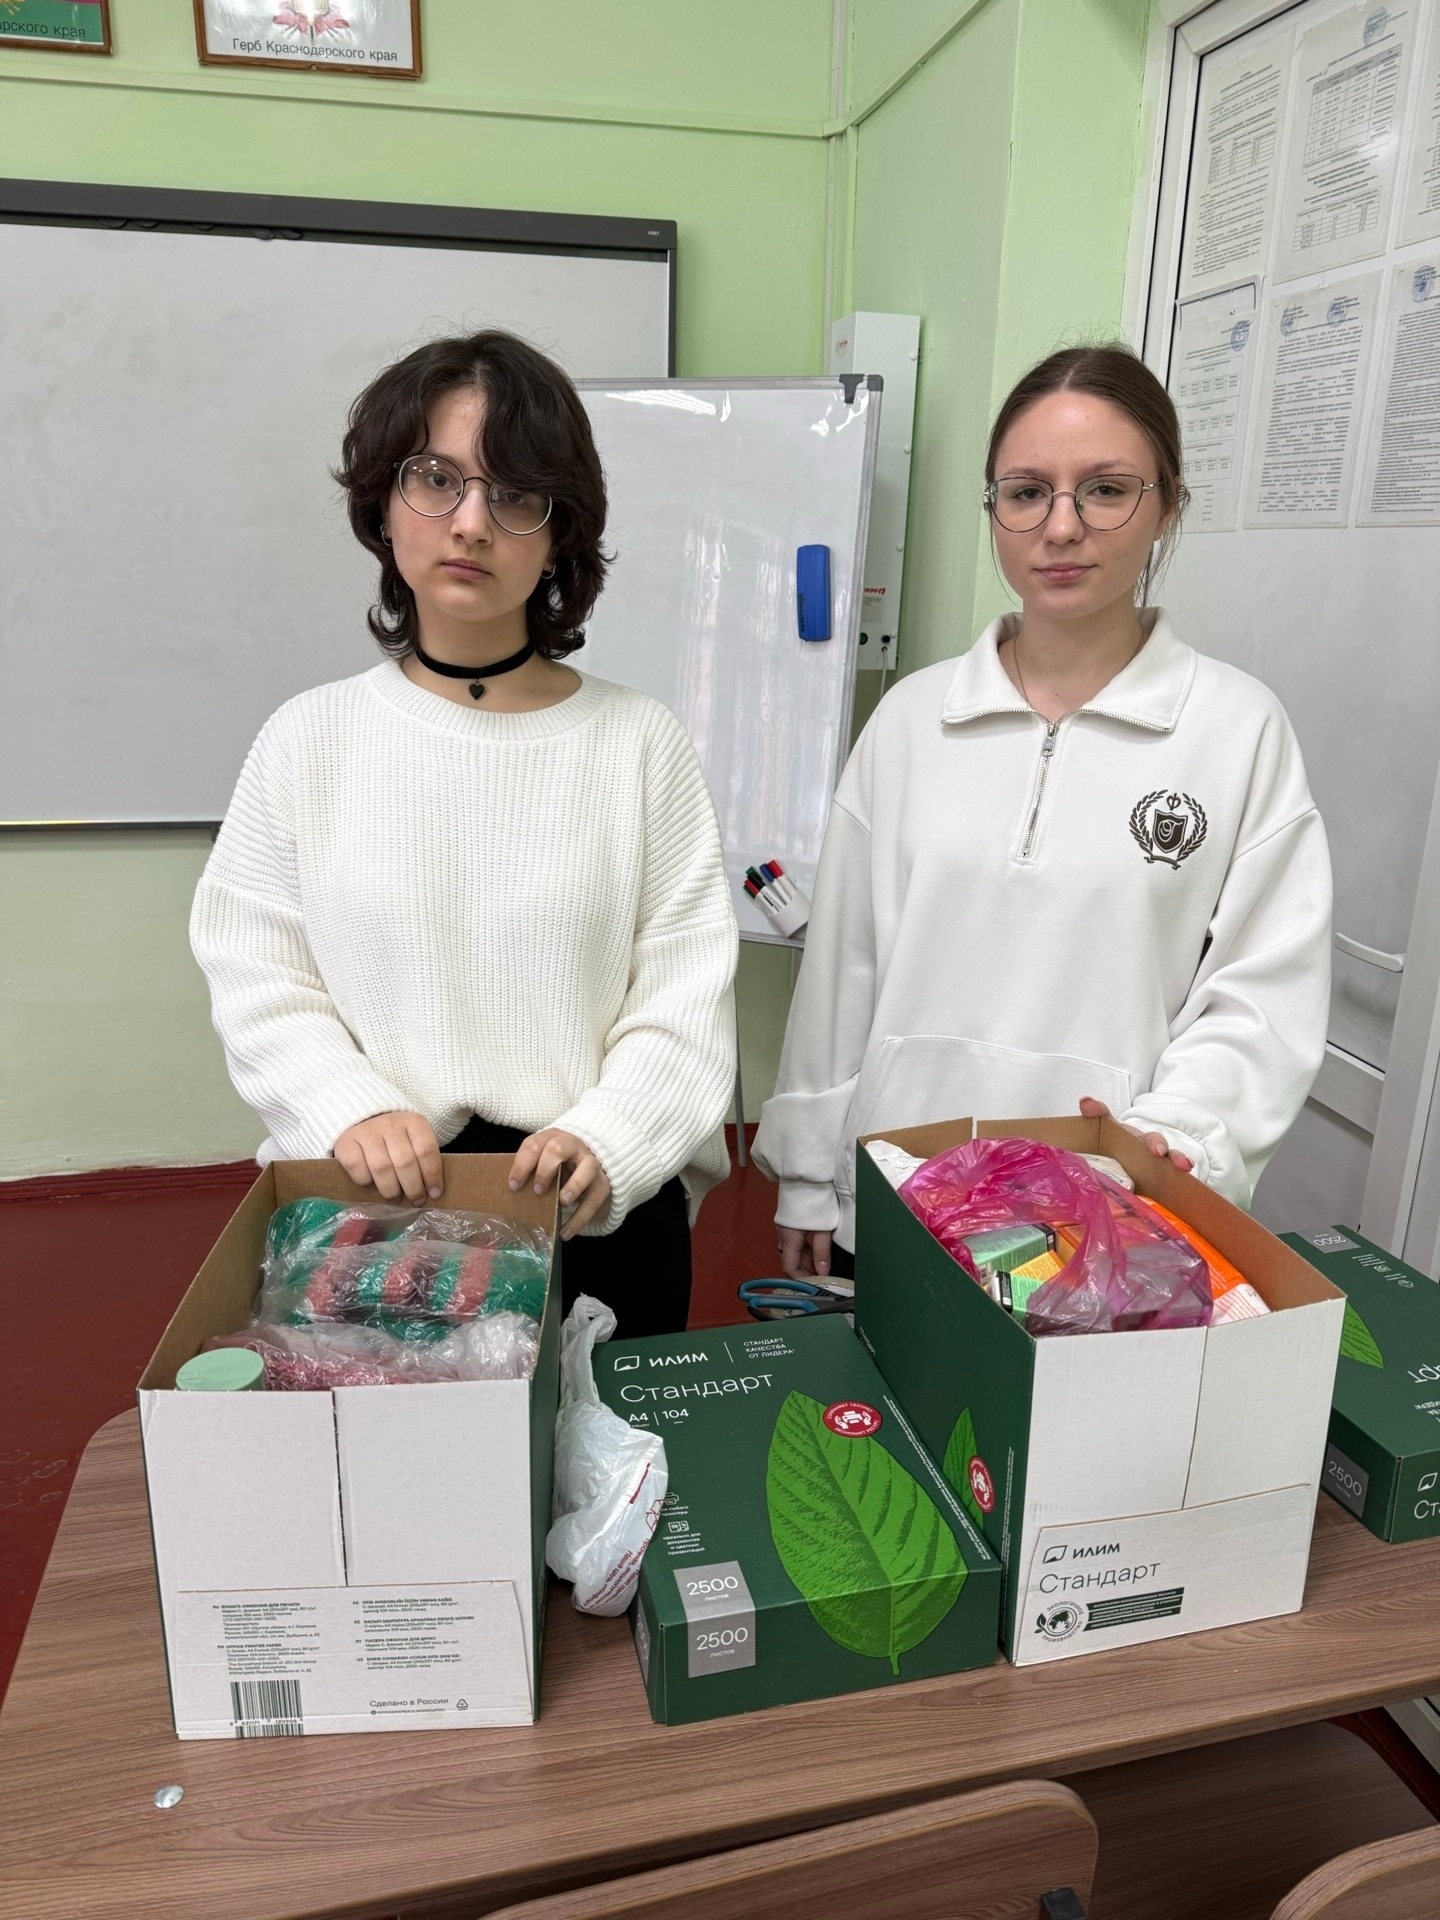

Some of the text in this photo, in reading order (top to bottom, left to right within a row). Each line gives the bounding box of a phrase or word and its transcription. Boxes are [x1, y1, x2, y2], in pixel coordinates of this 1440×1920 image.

[53, 25, 86, 38] края
[232, 38, 398, 63] Герб Краснодарского края
[743, 1337, 784, 1347] СТАНДАРТ
[745, 1343, 787, 1353] КАЧЕСТВА
[649, 1352, 709, 1368] ИЛИМ
[620, 1374, 773, 1403] Стандарт
[662, 1408, 690, 1420] 104
[1328, 1460, 1362, 1497] 2500
[1414, 1499, 1440, 1519] Ст
[1072, 1542, 1121, 1559] ИЛИМ
[686, 1576, 739, 1596] 2500
[1039, 1562, 1162, 1594] Стандарт
[704, 1593, 730, 1602] листов
[1046, 1600, 1084, 1616] ЭКОЛОГИЧНОЕ
[696, 1627, 749, 1651] 2500
[1041, 1620, 1083, 1643] ПРОИЗВОДСТВО
[709, 1648, 735, 1658] листов
[369, 1700, 408, 1708] Сделано
